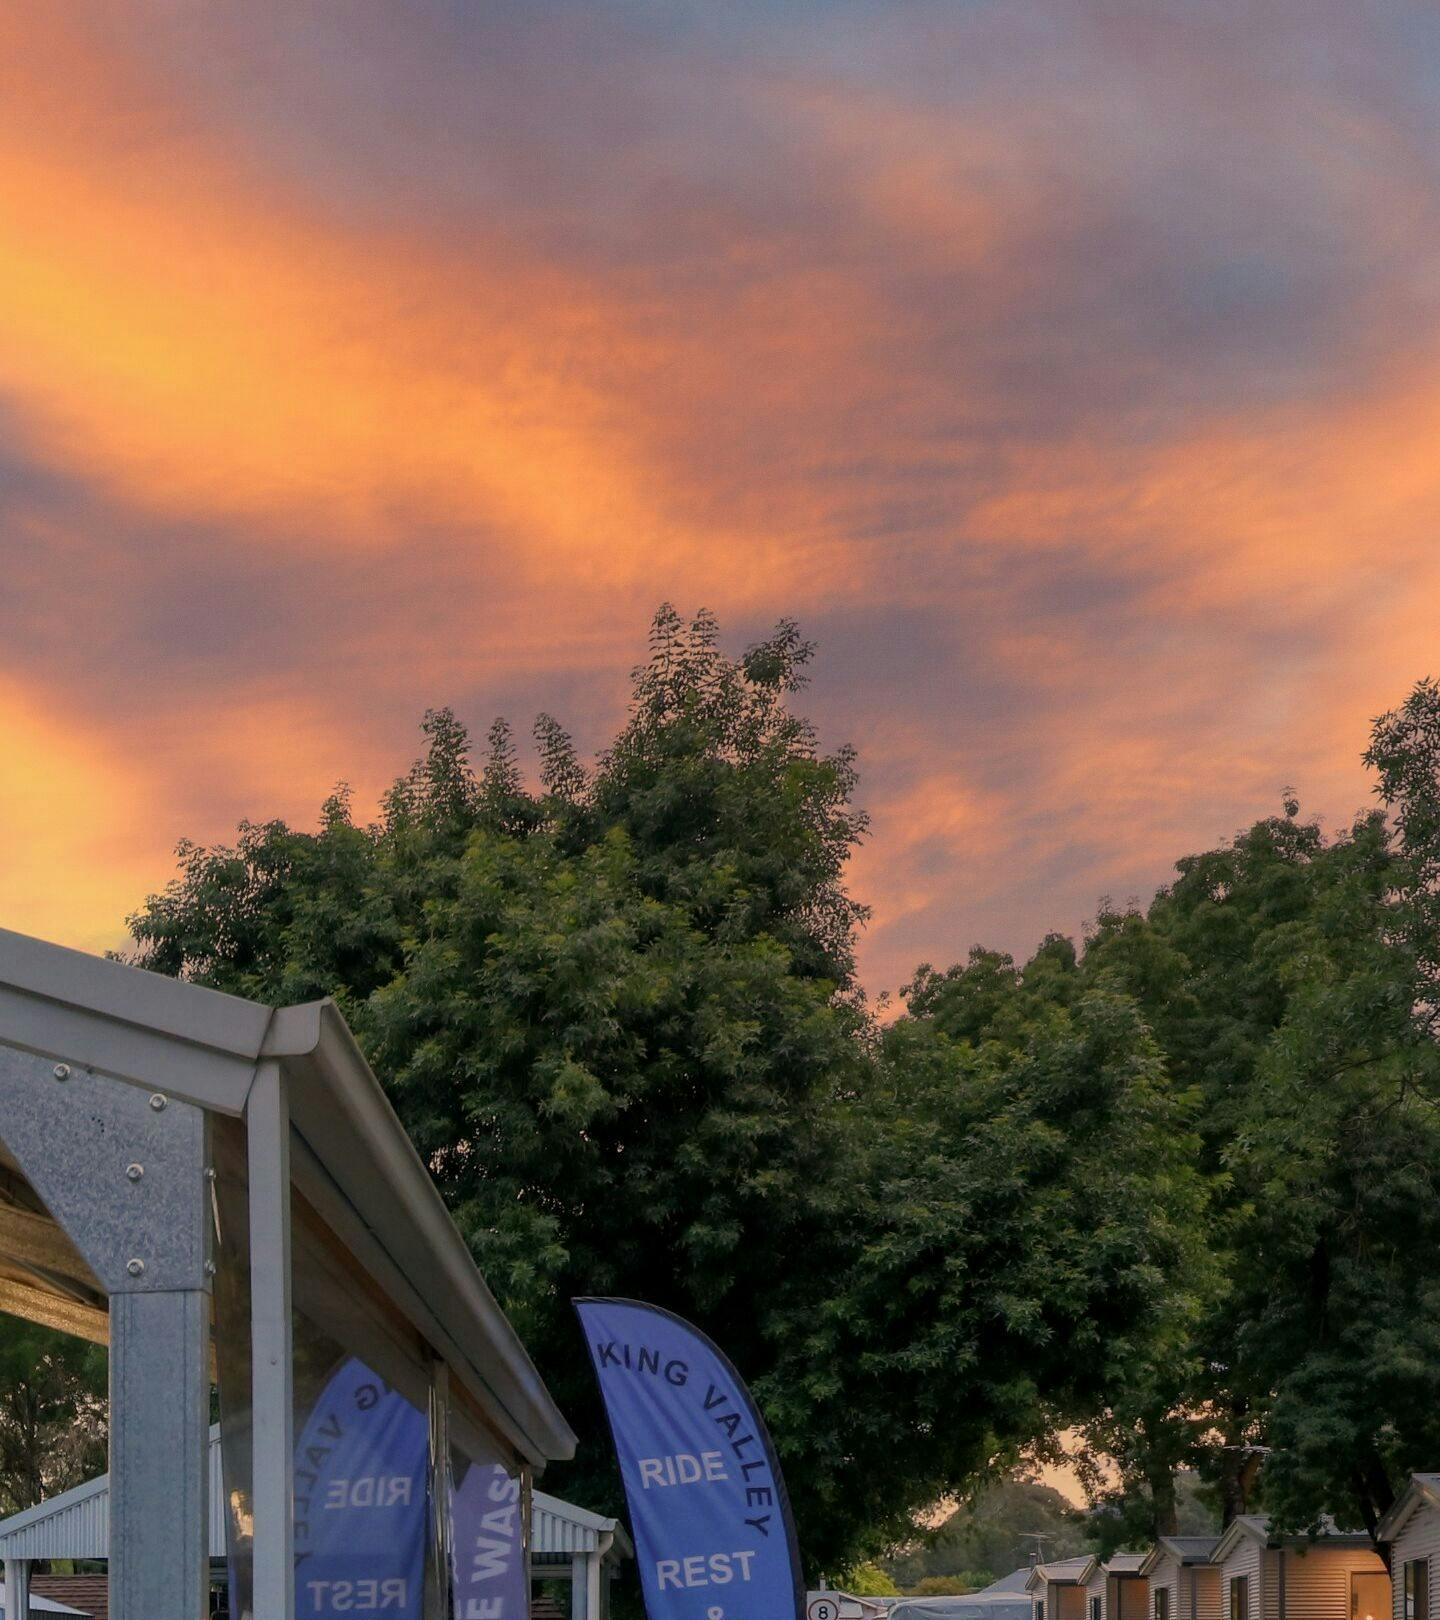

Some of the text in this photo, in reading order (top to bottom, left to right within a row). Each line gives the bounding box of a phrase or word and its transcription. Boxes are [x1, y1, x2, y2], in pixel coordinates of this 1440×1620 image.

[597, 1342, 773, 1537] KING VALLEY
[638, 1451, 729, 1489] RIDE
[656, 1551, 756, 1590] REST
[818, 1606, 829, 1620] 8
